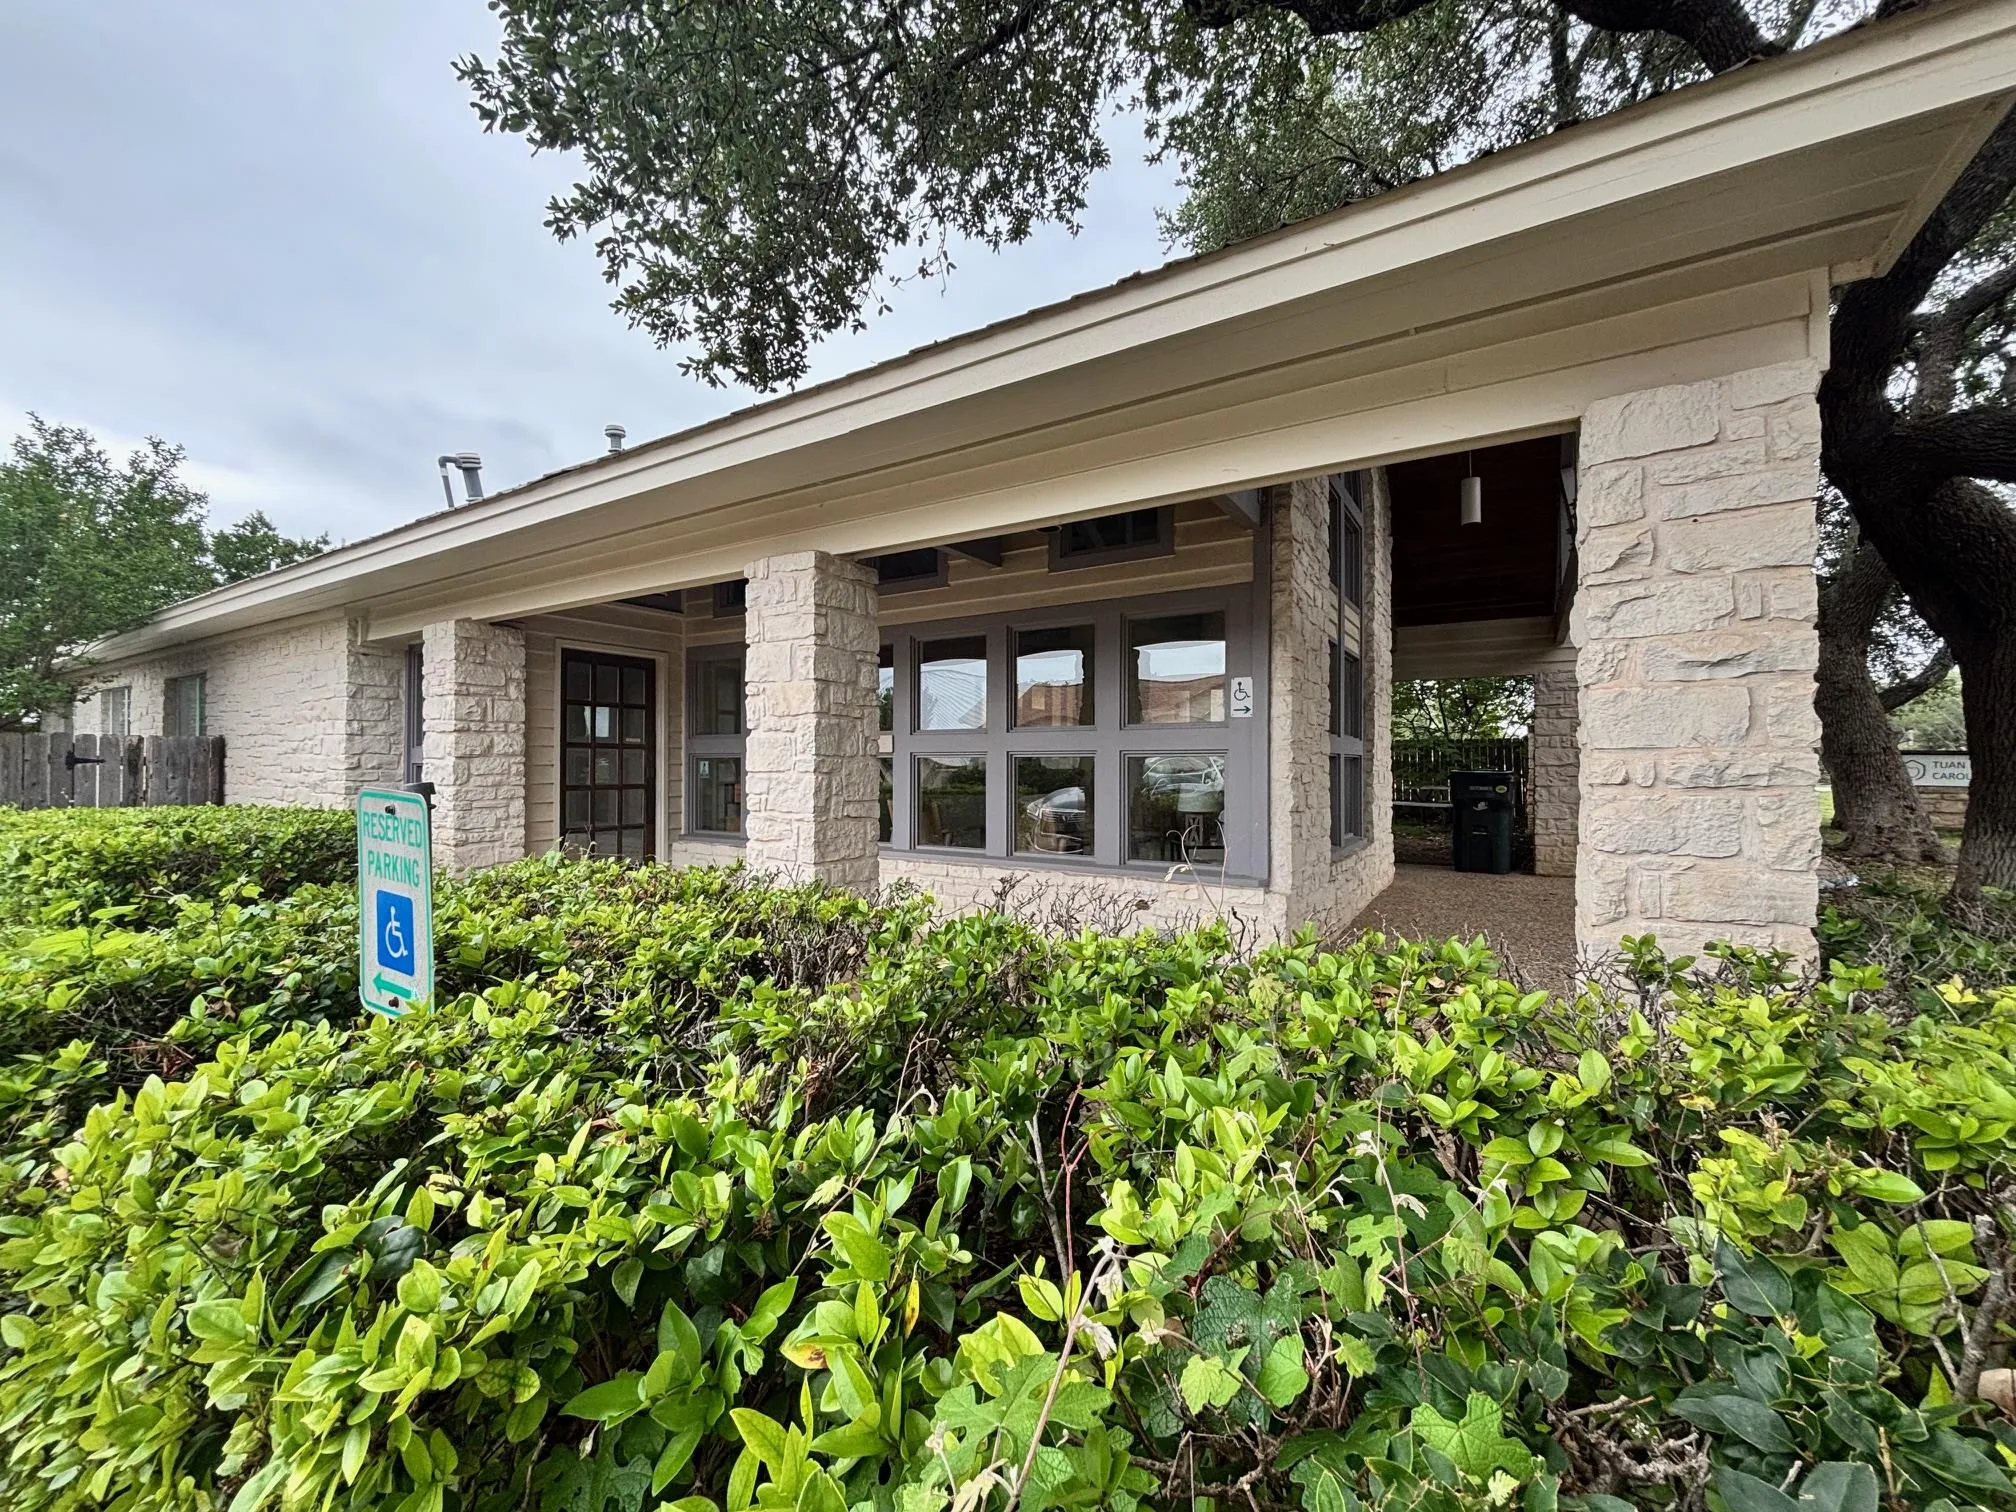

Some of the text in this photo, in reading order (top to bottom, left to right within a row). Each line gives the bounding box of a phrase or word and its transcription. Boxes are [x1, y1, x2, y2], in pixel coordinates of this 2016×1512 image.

[1932, 761, 1966, 769] TUAN
[363, 811, 422, 848] RESERVED
[368, 850, 420, 887] PARKING
